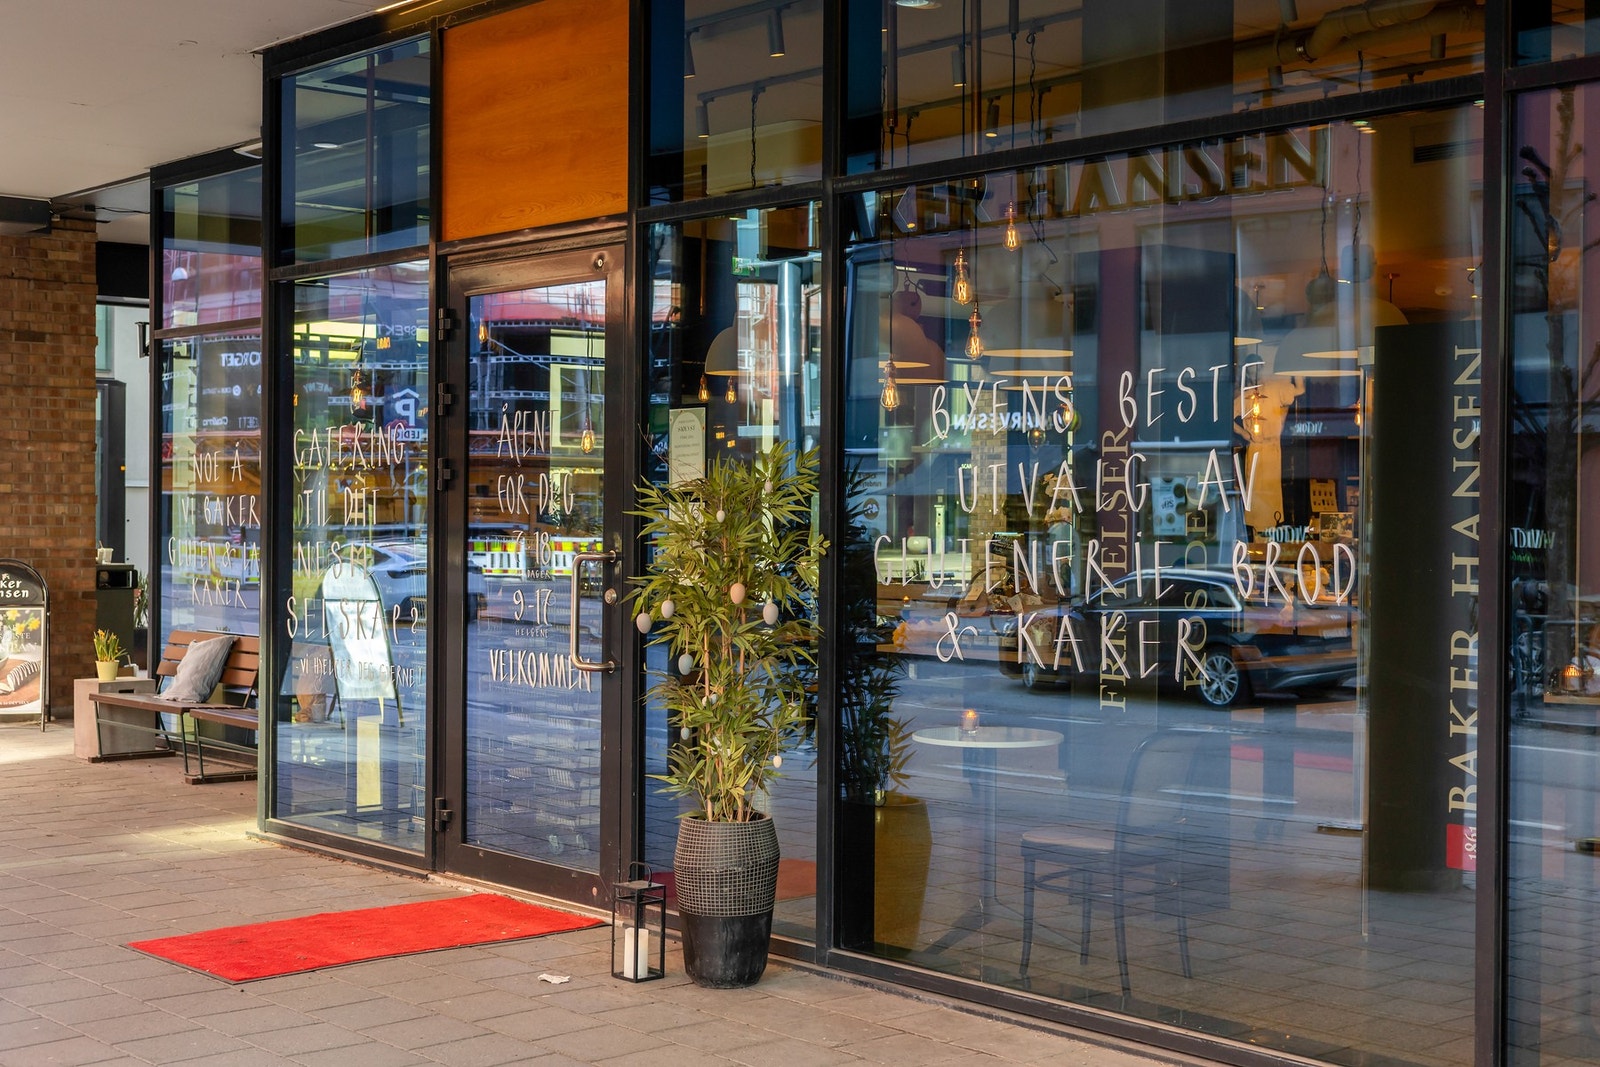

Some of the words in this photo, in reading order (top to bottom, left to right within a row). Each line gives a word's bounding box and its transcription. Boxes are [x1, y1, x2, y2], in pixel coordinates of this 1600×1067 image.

[932, 375, 1075, 439] BYENS
[1119, 361, 1266, 428] BESTE
[293, 421, 406, 471] CATERING
[497, 402, 560, 468] ÅPENT
[193, 451, 222, 483] NOE
[958, 452, 1151, 517] UTVALG
[1198, 448, 1259, 513] AV
[1452, 344, 1482, 597] HANSEN
[203, 494, 261, 529] BAKER
[497, 473, 530, 515] FOR
[539, 472, 576, 516] DEG
[168, 536, 217, 569] GLUTEN
[191, 577, 248, 609] KAKER
[512, 589, 553, 627] 9-17
[936, 611, 979, 663] &
[1017, 611, 1211, 683] KAKER
[489, 649, 592, 693] VELKOMMEN
[1448, 629, 1478, 813] BAKER
